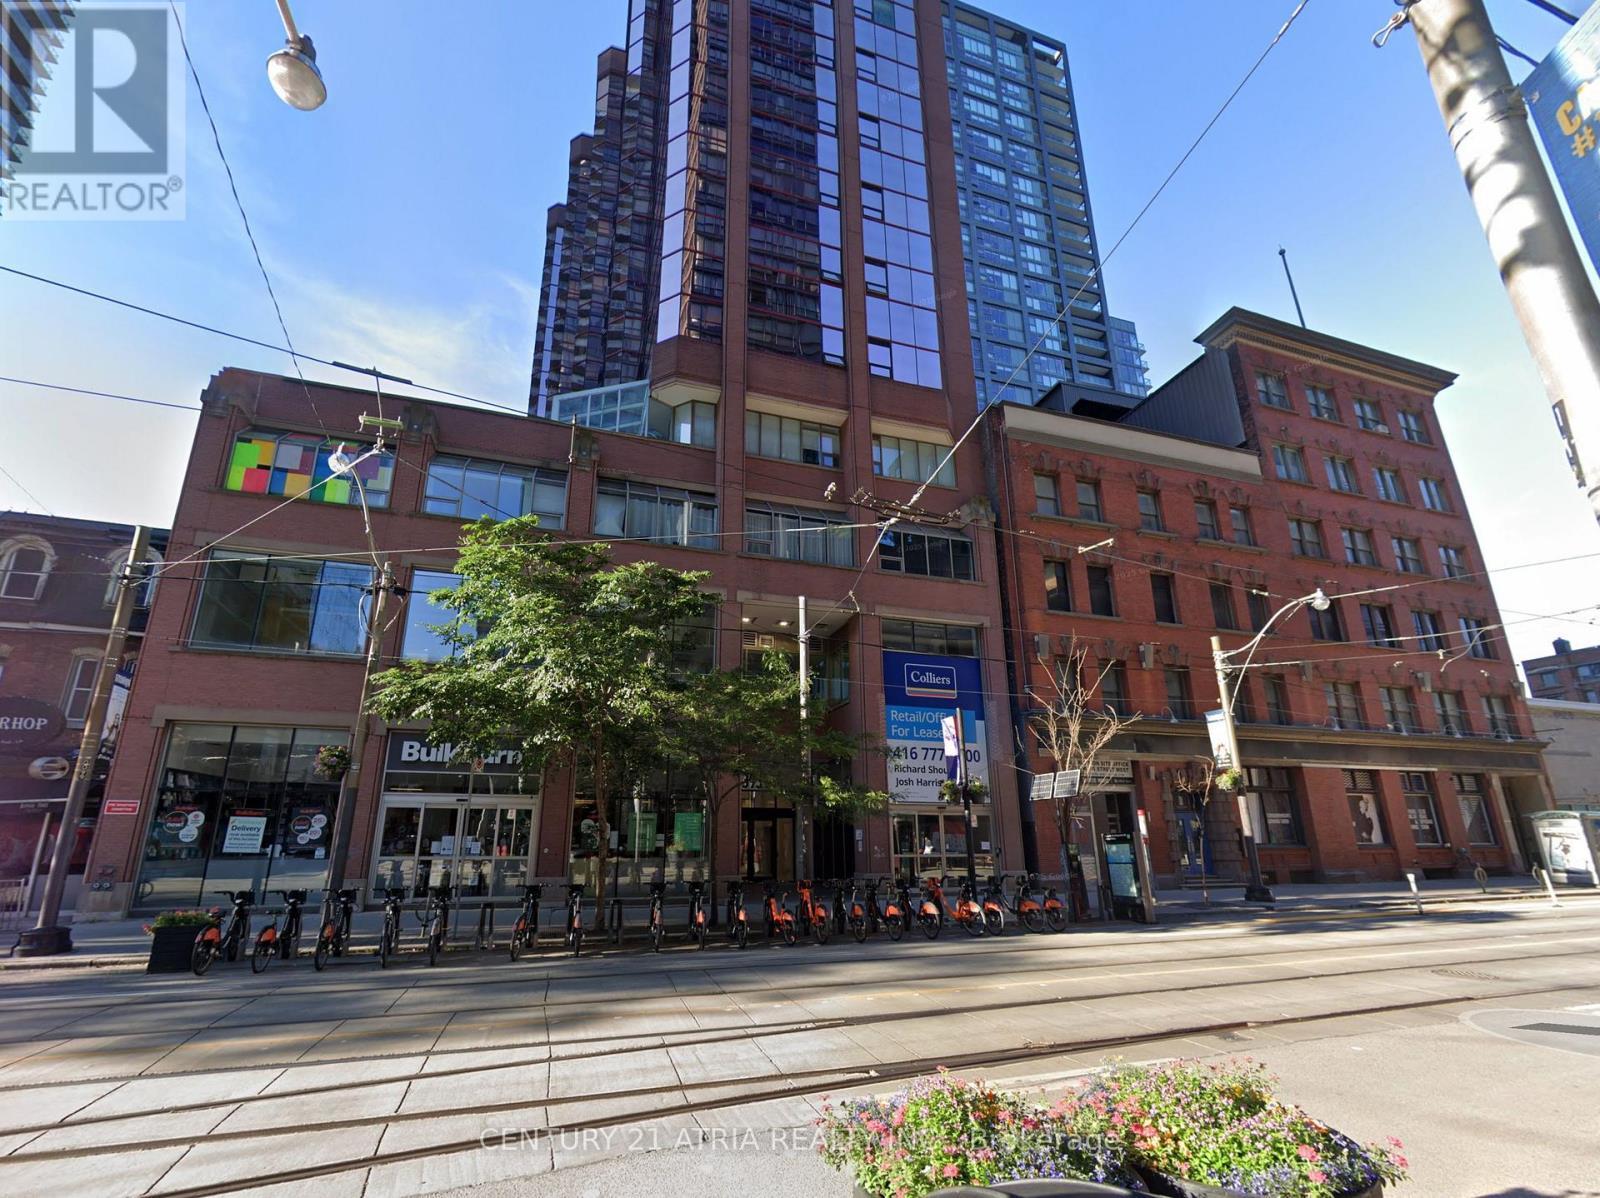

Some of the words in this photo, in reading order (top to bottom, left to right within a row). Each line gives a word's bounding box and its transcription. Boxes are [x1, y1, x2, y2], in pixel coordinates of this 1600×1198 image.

[910, 671, 951, 685] Colliers
[891, 725, 910, 737] For
[913, 726, 944, 738] Lease
[401, 741, 457, 762] Bulk
[893, 746, 918, 760] 416
[921, 748, 945, 761] 777
[894, 765, 926, 774] Richard
[895, 777, 914, 788] Josh
[231, 825, 261, 833] Delivery
